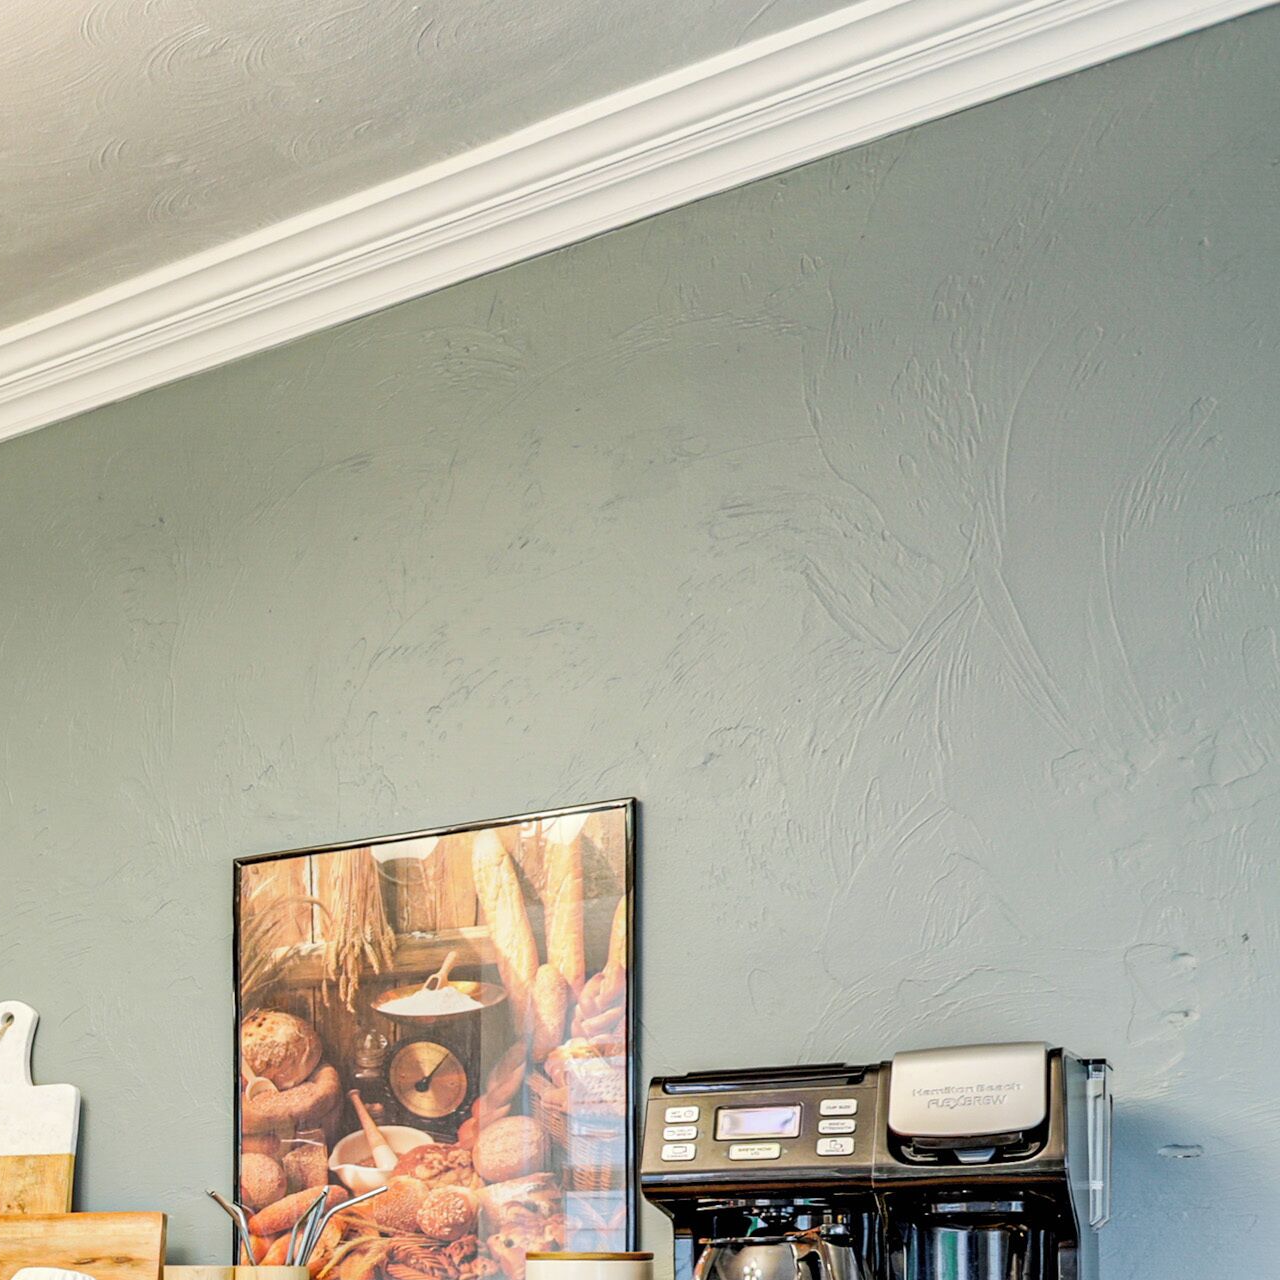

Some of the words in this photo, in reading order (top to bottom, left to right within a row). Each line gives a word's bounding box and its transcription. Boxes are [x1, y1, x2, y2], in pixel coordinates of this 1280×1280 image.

[912, 1085, 974, 1097] Hamilton
[976, 1082, 1022, 1093] Beach
[927, 1094, 1008, 1110] FLEXBREW
